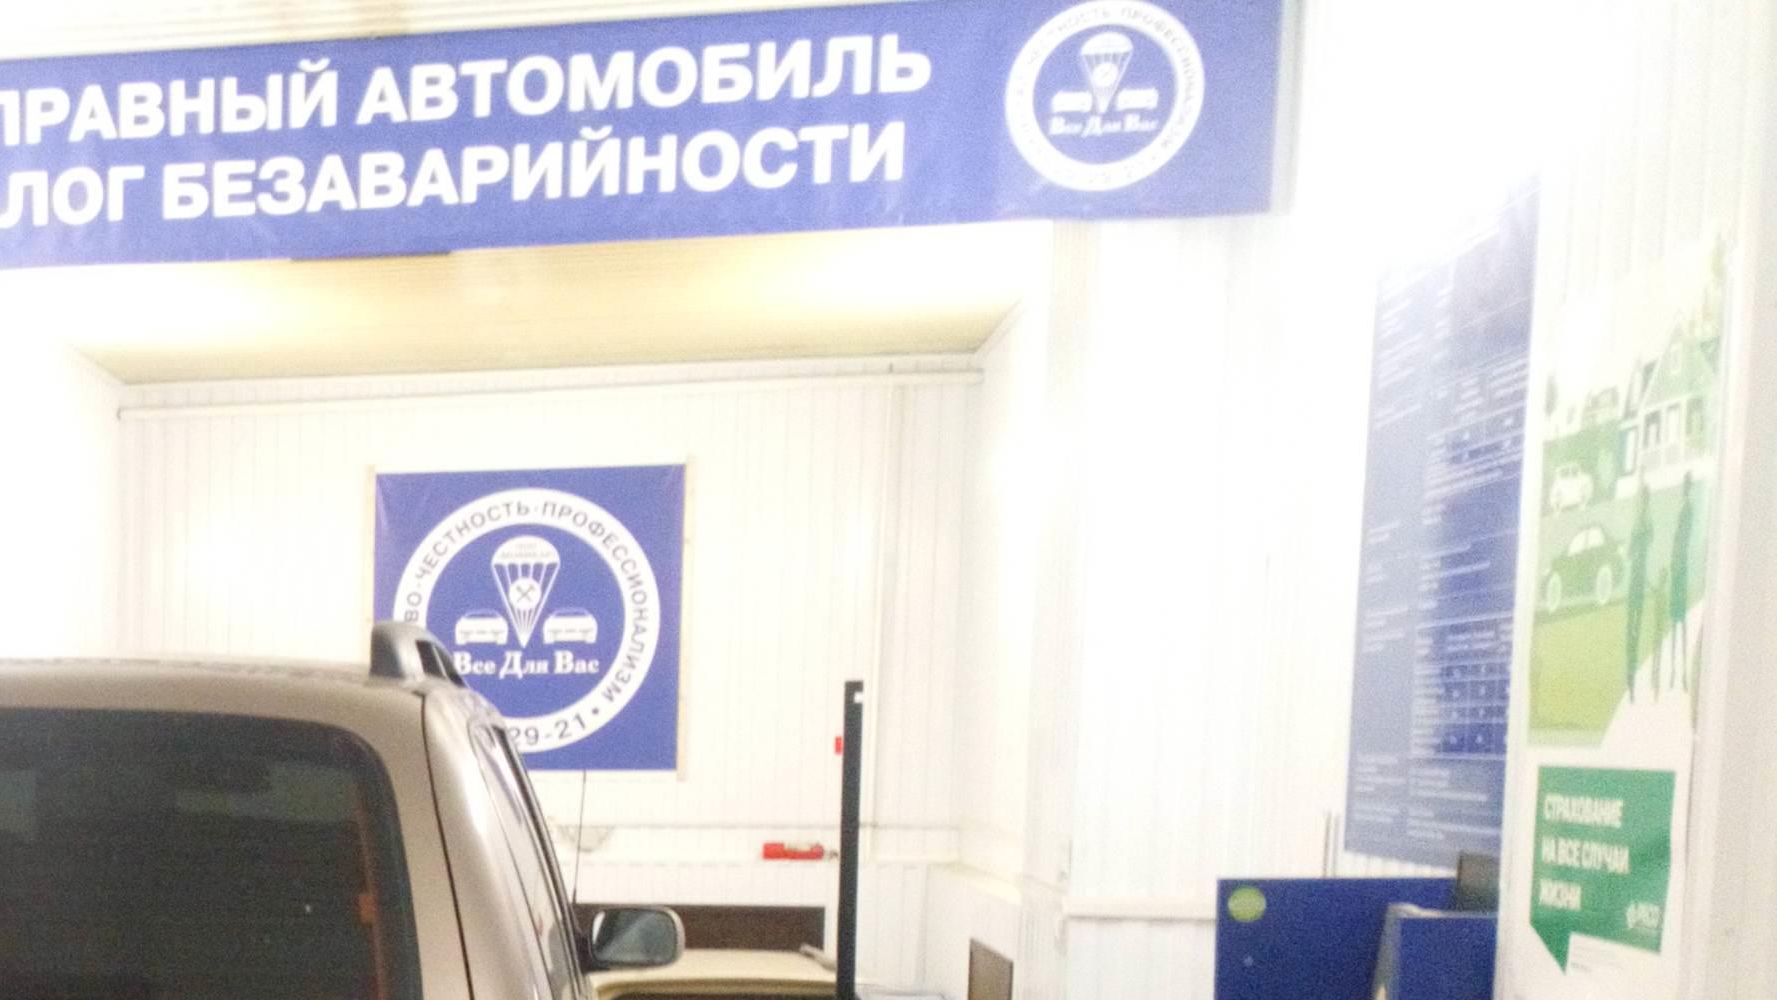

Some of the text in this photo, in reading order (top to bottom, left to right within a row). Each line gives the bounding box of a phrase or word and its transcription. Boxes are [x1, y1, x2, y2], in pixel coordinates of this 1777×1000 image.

[356, 33, 932, 125] АВТОМОБИЛЬ
[162, 120, 907, 220] БЕЗАВАРИЙНОСТИ
[414, 501, 530, 579] ЧЕСТНОСТЬ
[541, 501, 649, 702] ПРОФЕССИОНАЛИЗМ
[453, 650, 600, 679] Все Для Вас
